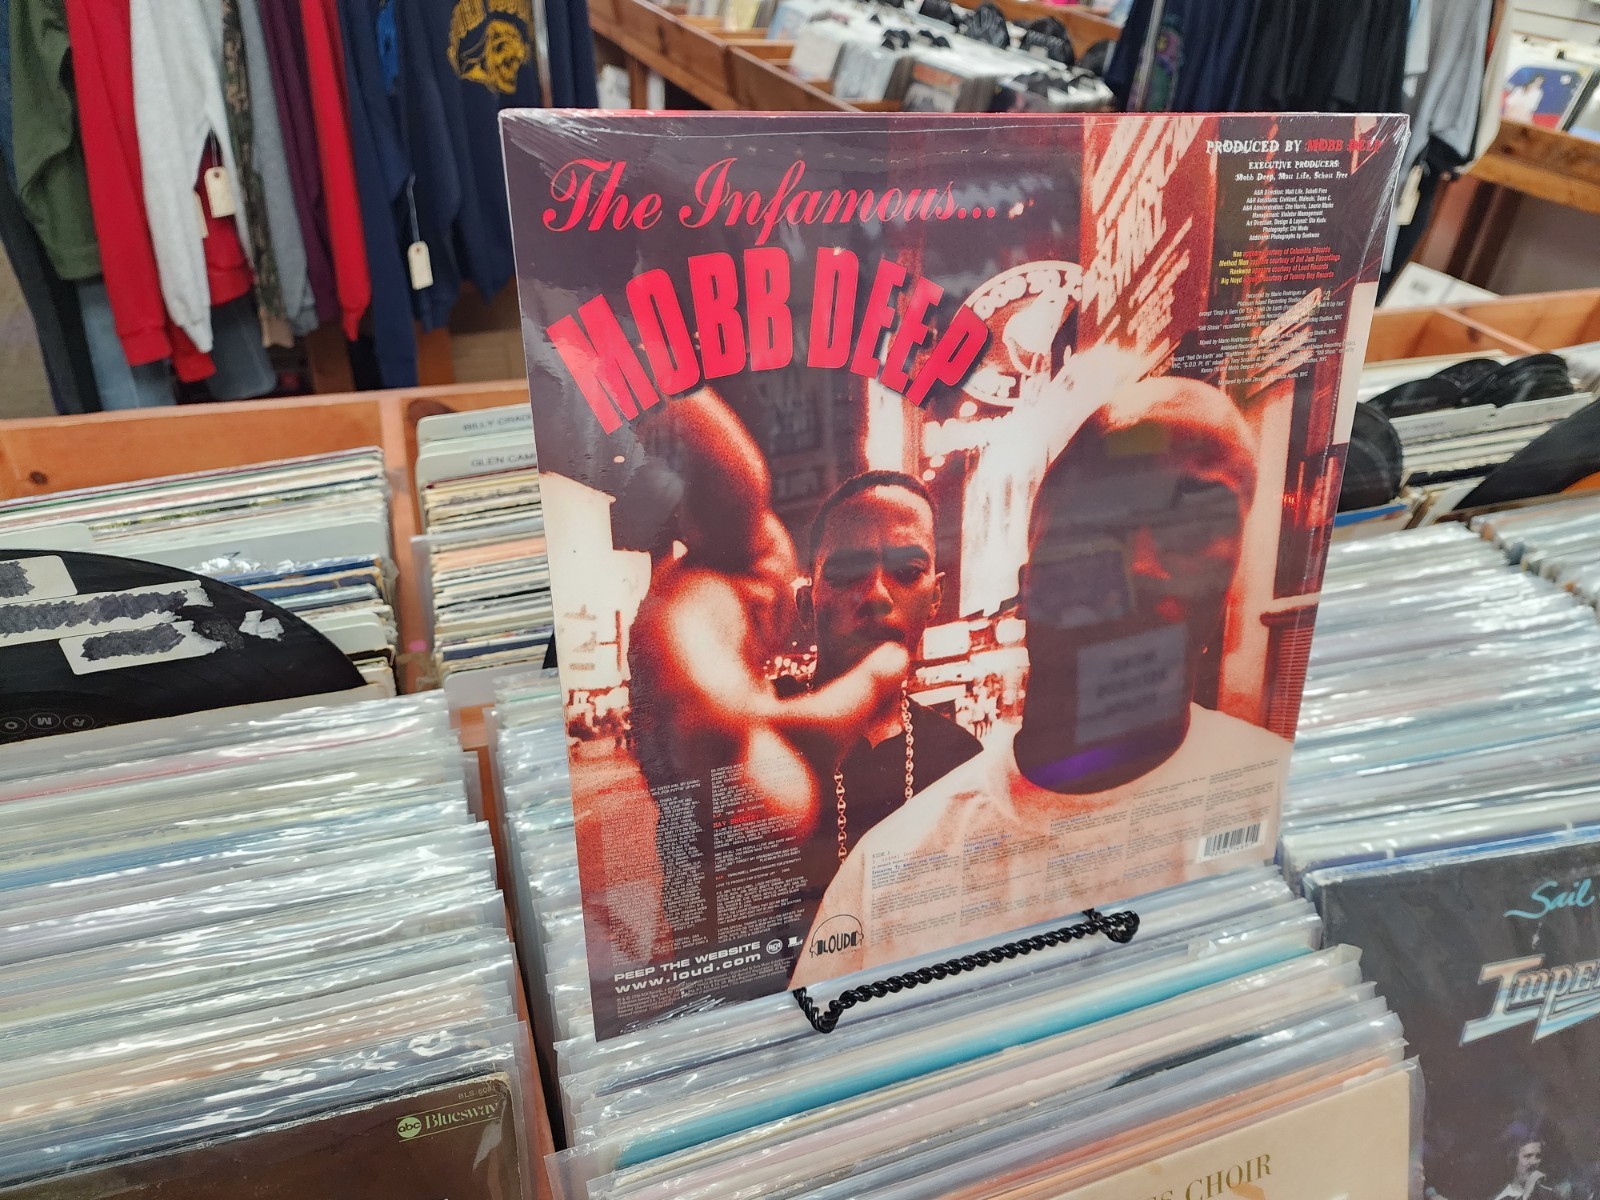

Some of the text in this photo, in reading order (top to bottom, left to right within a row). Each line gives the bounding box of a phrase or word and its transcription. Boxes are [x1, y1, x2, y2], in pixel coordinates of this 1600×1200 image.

[1205, 139, 1280, 154] PRODUCED
[1285, 139, 1302, 153] BY
[1304, 139, 1344, 153] MOBB
[1234, 172, 1348, 182] Mobb Deep, Matt Life, Schott Free
[1248, 160, 1292, 170] EXECUTIVE
[542, 157, 996, 246] The Infamous...
[1219, 259, 1237, 267] Method
[546, 247, 988, 435] MOBB DEEP
[471, 456, 504, 467] GLEN
[1503, 878, 1595, 919] Sail
[822, 932, 854, 954] LOUD
[614, 941, 761, 982] PEEP THE WEBSITE
[615, 953, 761, 994] www.loud.com
[458, 1090, 475, 1100] BLS
[398, 1101, 500, 1133] abc Bluesway
[1185, 1153, 1272, 1200] CHOIR
